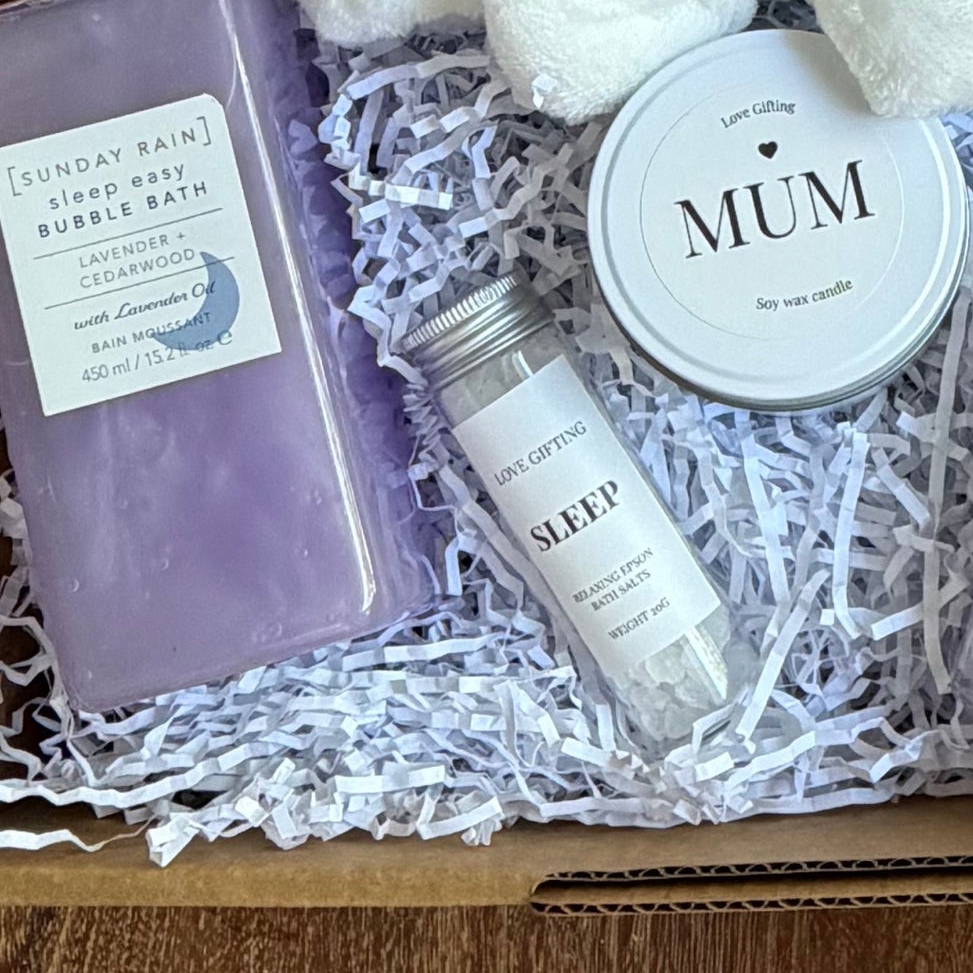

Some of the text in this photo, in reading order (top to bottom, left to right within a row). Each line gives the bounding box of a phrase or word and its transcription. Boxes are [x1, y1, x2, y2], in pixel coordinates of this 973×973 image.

[720, 99, 796, 129] Love Gifting
[50, 163, 185, 210] sleep easy
[38, 181, 208, 238] BUBBLE BATH
[674, 160, 875, 259] MUM
[80, 234, 169, 268] LAVENDER
[80, 248, 195, 289] CEDARWOOD
[74, 280, 216, 330] with Lavender Oil
[756, 278, 854, 312] Soy wax candle
[92, 312, 212, 353] BAIN MOUSSANT
[82, 364, 109, 383] 450
[113, 357, 131, 376] ml
[494, 420, 588, 487] LOVE GIFTING
[530, 479, 621, 553] SLEEP
[572, 570, 621, 603] RELAXING
[590, 568, 651, 611] BATH SALTS
[608, 597, 670, 640] WEIGHT 20G
